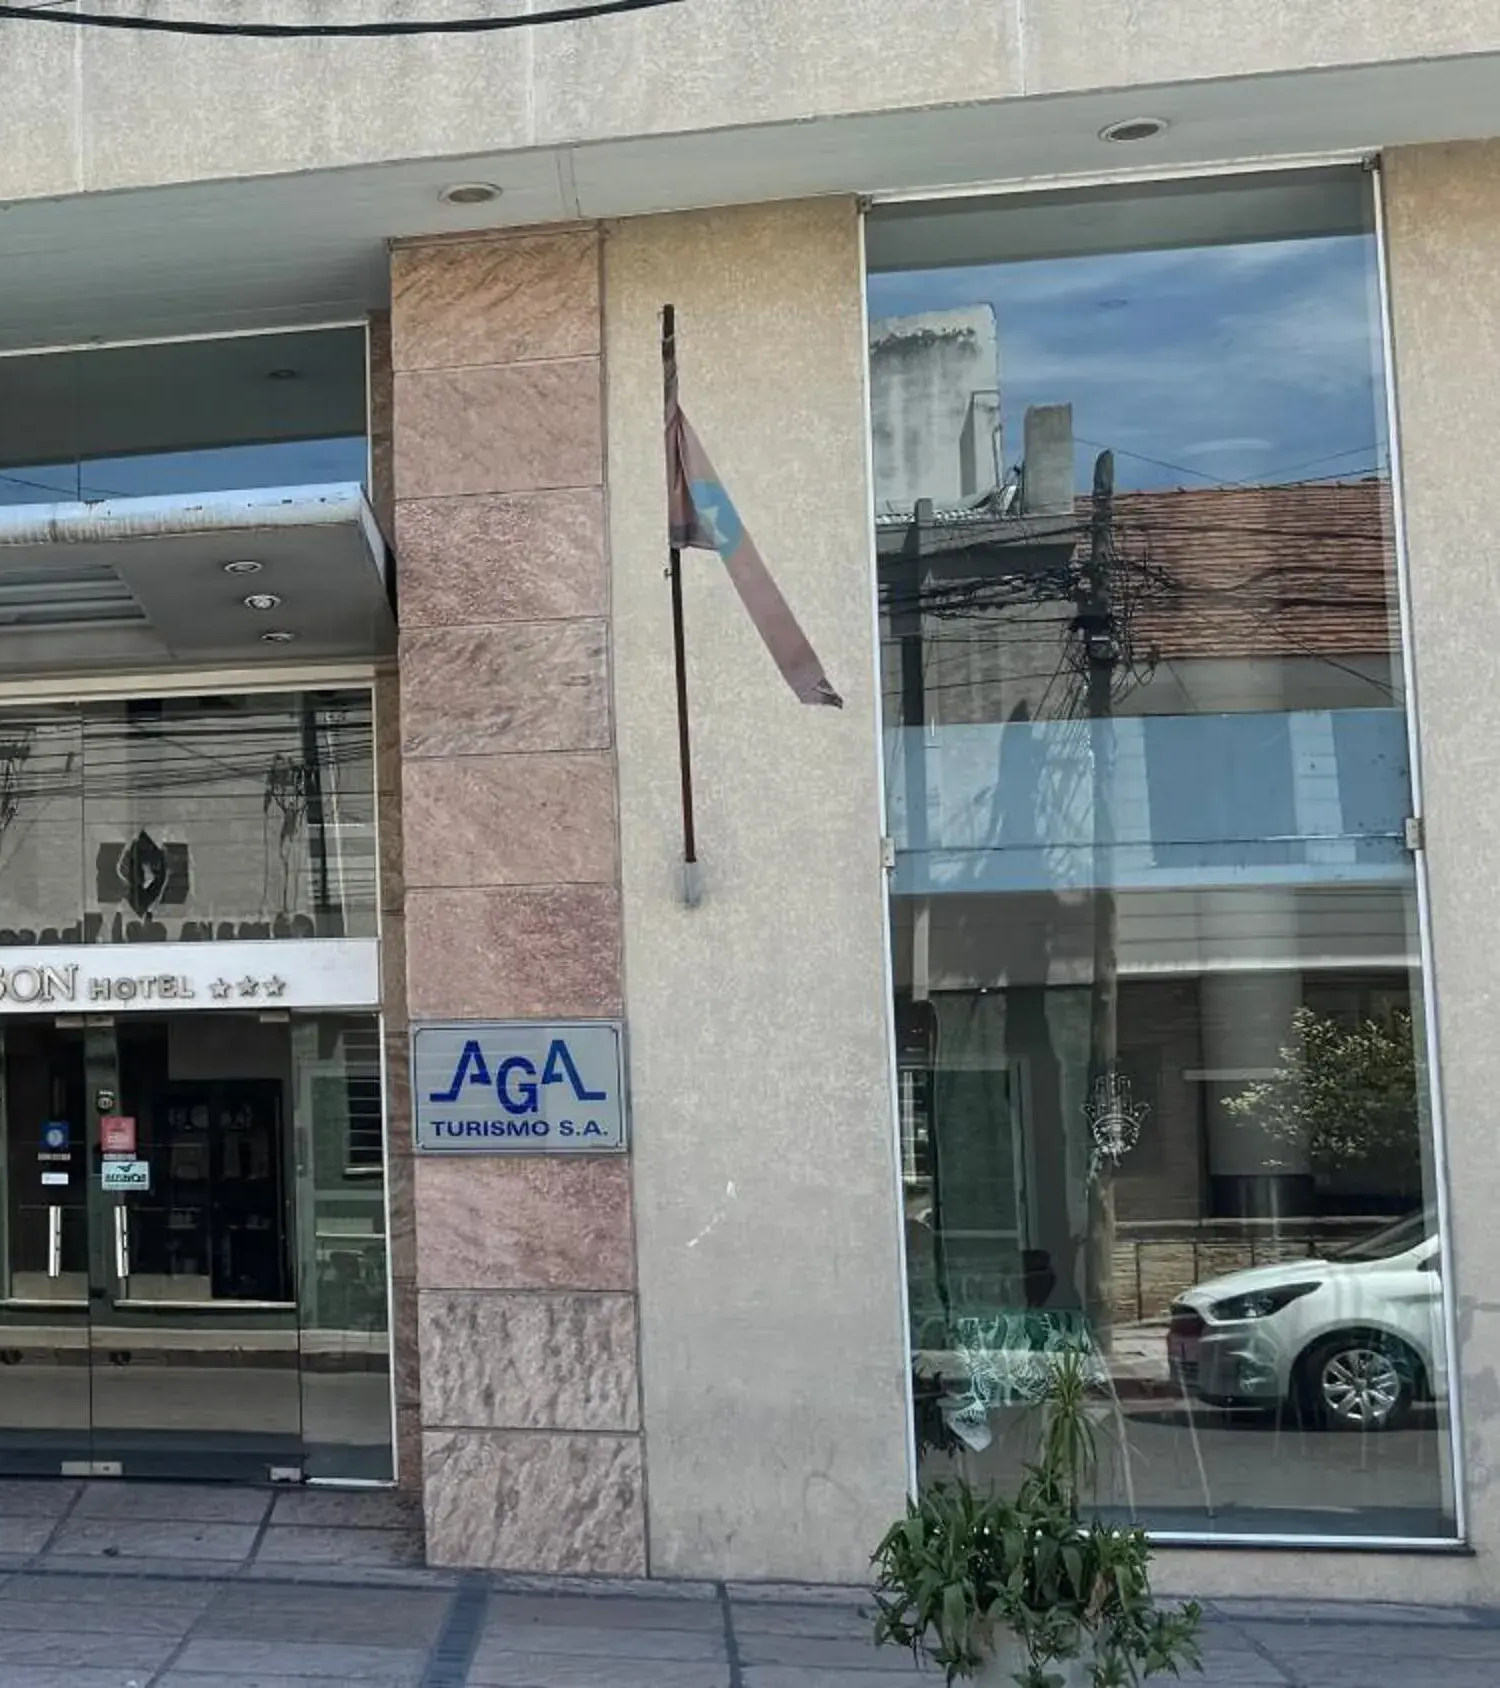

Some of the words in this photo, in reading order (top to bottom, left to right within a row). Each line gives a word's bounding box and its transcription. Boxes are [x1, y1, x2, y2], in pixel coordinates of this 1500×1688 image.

[89, 974, 195, 1002] HOTEL
[429, 1039, 607, 1115] AGA
[430, 1119, 550, 1138] TURISMO
[558, 1119, 609, 1138] S.A.
